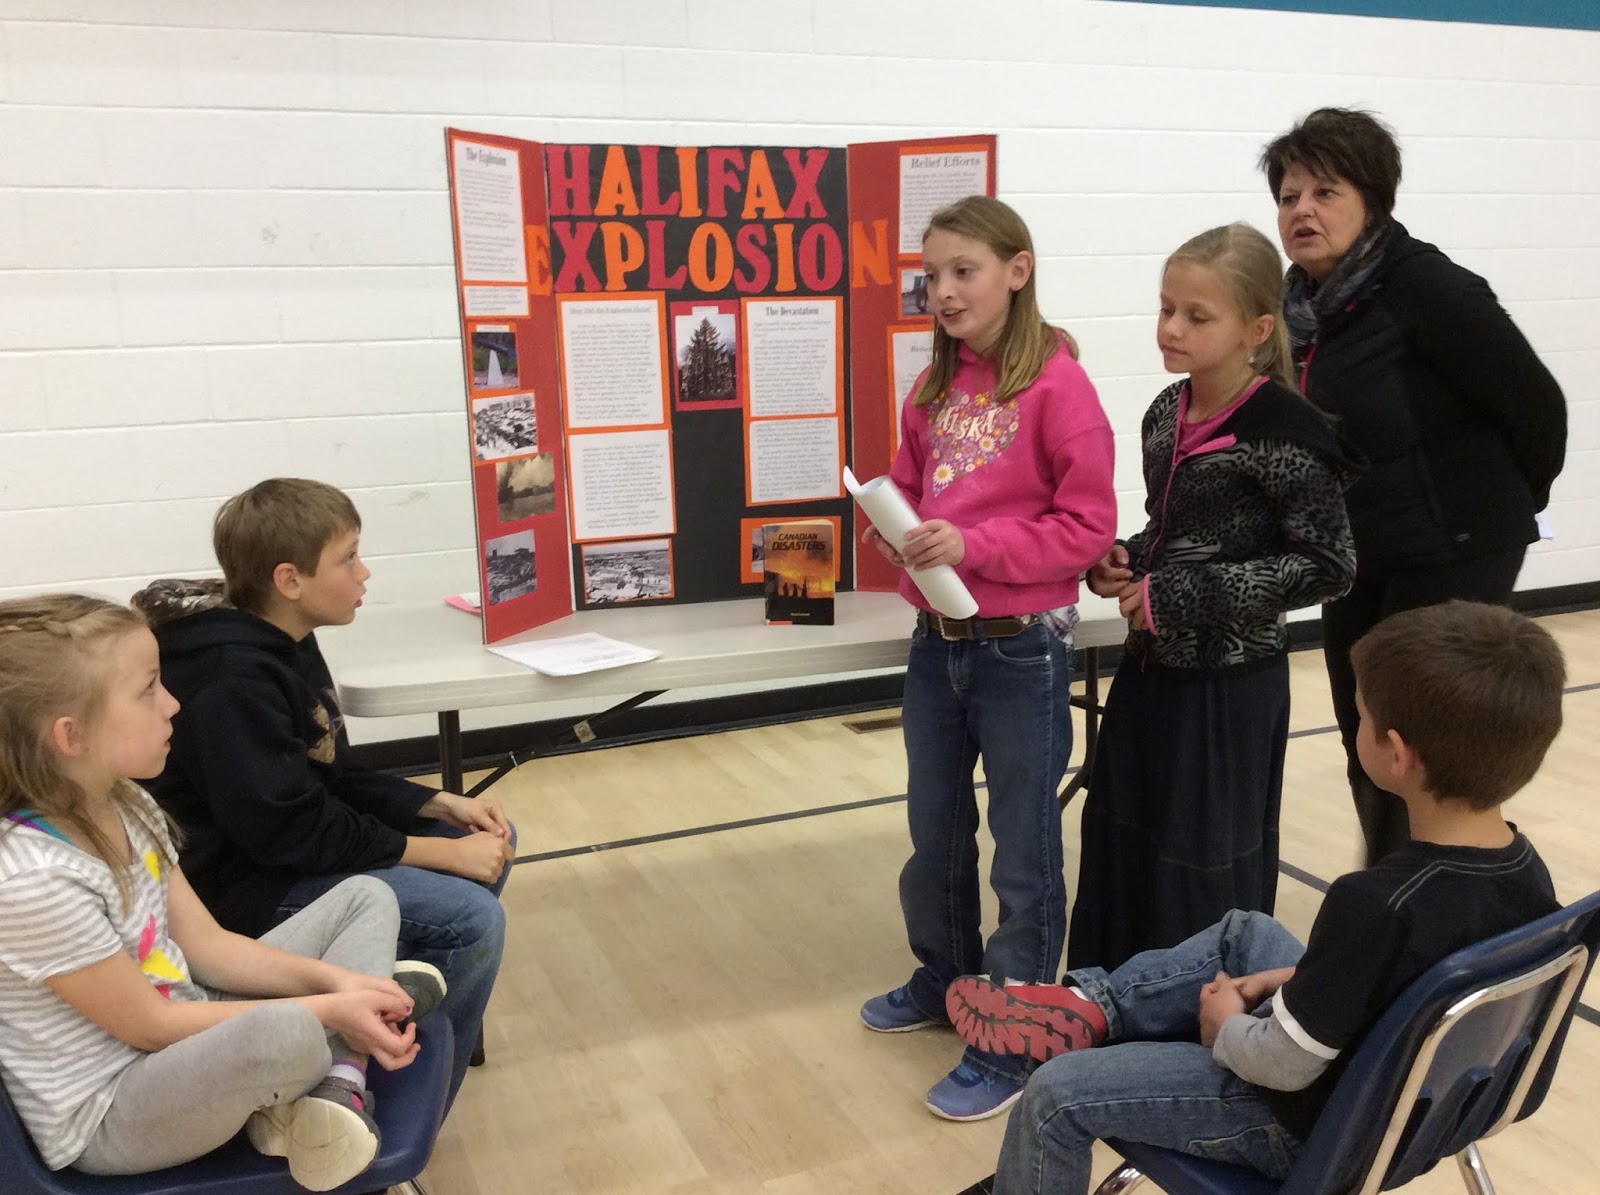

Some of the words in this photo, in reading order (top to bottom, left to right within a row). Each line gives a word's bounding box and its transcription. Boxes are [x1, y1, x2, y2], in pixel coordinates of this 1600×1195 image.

[466, 147, 477, 160] The
[911, 157, 940, 169] Relief
[943, 155, 981, 168] Efforts
[546, 146, 829, 218] HALIFAX
[526, 220, 891, 296] EXPLOSION
[766, 306, 778, 316] The
[780, 305, 819, 316] Devastation
[778, 533, 818, 541] CANADIAN
[772, 541, 826, 551] DISASTERS
